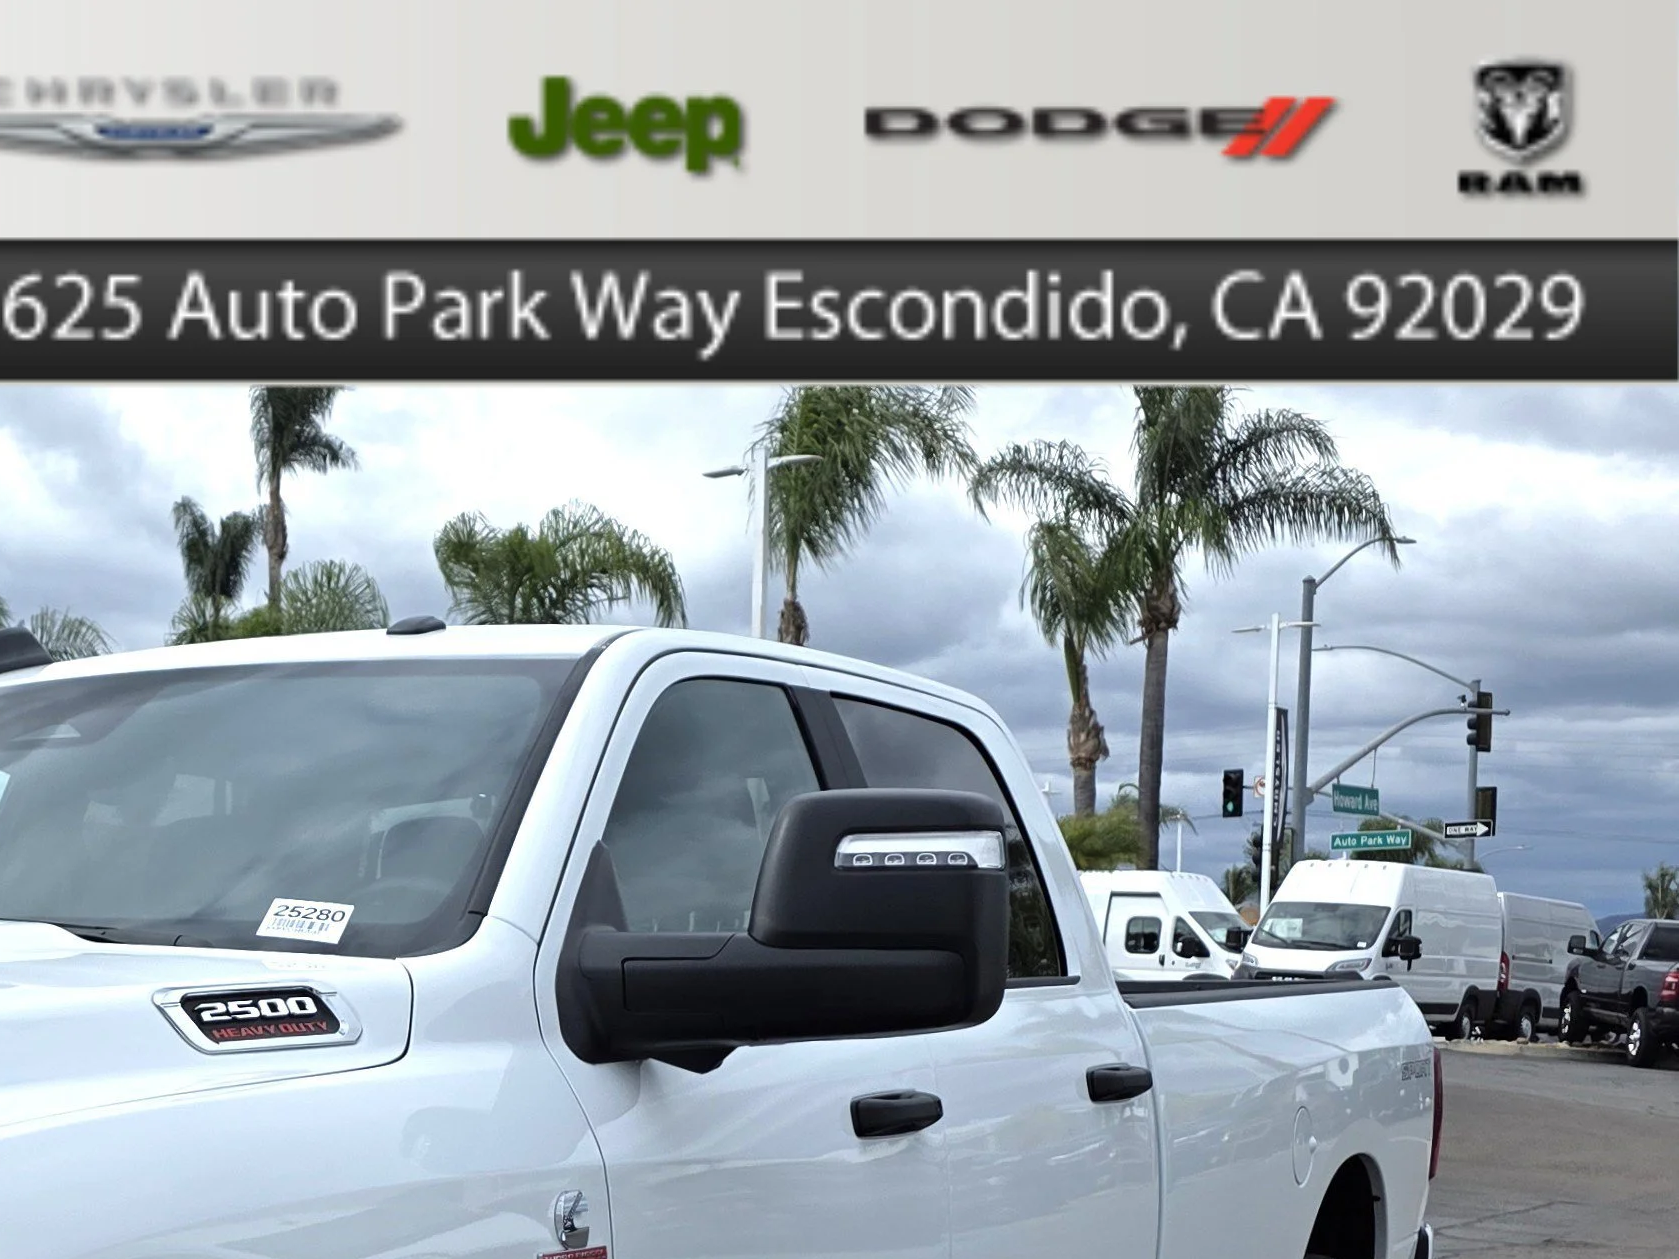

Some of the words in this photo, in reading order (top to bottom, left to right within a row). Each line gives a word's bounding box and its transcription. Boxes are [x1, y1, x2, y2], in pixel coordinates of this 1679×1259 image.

[1334, 790, 1362, 810] Howard
[1365, 794, 1378, 811] Ave
[1334, 836, 1357, 847] Auto
[1361, 835, 1383, 846] Park
[1386, 834, 1407, 846] Way
[273, 904, 346, 922] 25280
[194, 996, 318, 1023] 2500
[212, 1024, 275, 1039] HEAVY
[277, 1021, 328, 1034] DUTY
